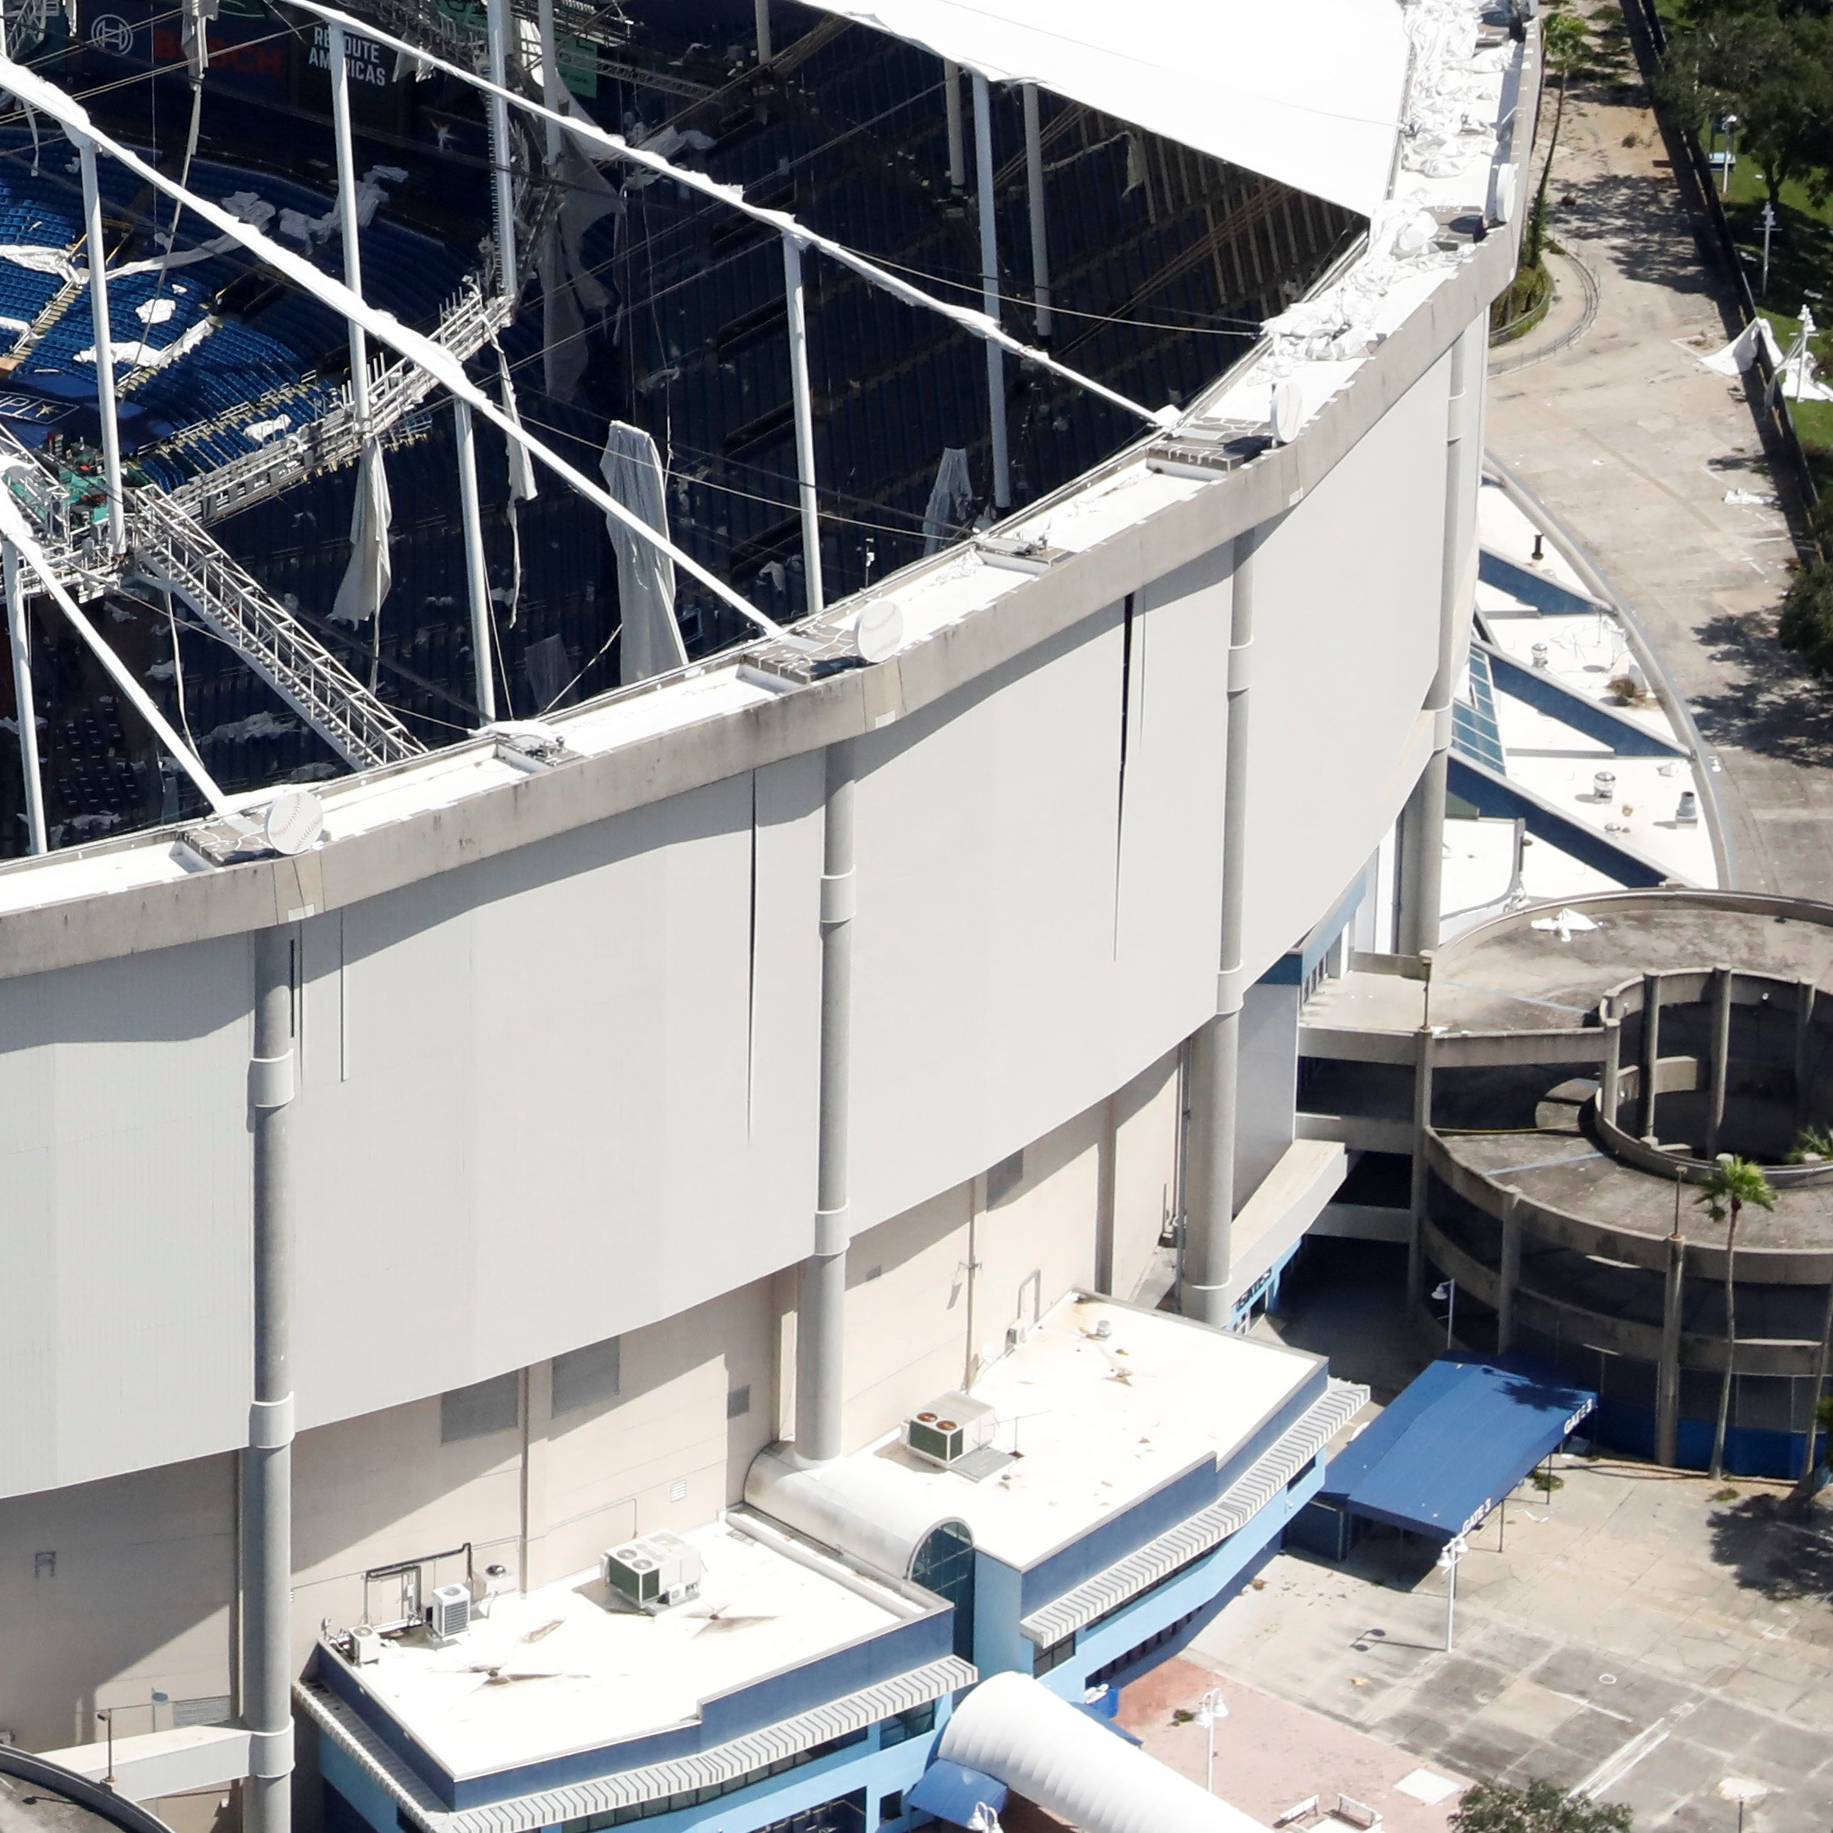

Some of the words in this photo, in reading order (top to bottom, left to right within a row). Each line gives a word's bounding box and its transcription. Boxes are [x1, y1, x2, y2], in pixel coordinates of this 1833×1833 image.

[154, 29, 283, 74] BSCH
[314, 26, 380, 64] REOUTE
[309, 49, 386, 86] AMRICAS
[1563, 1407, 1585, 1435] GATE
[1462, 1506, 1484, 1535] GATE
